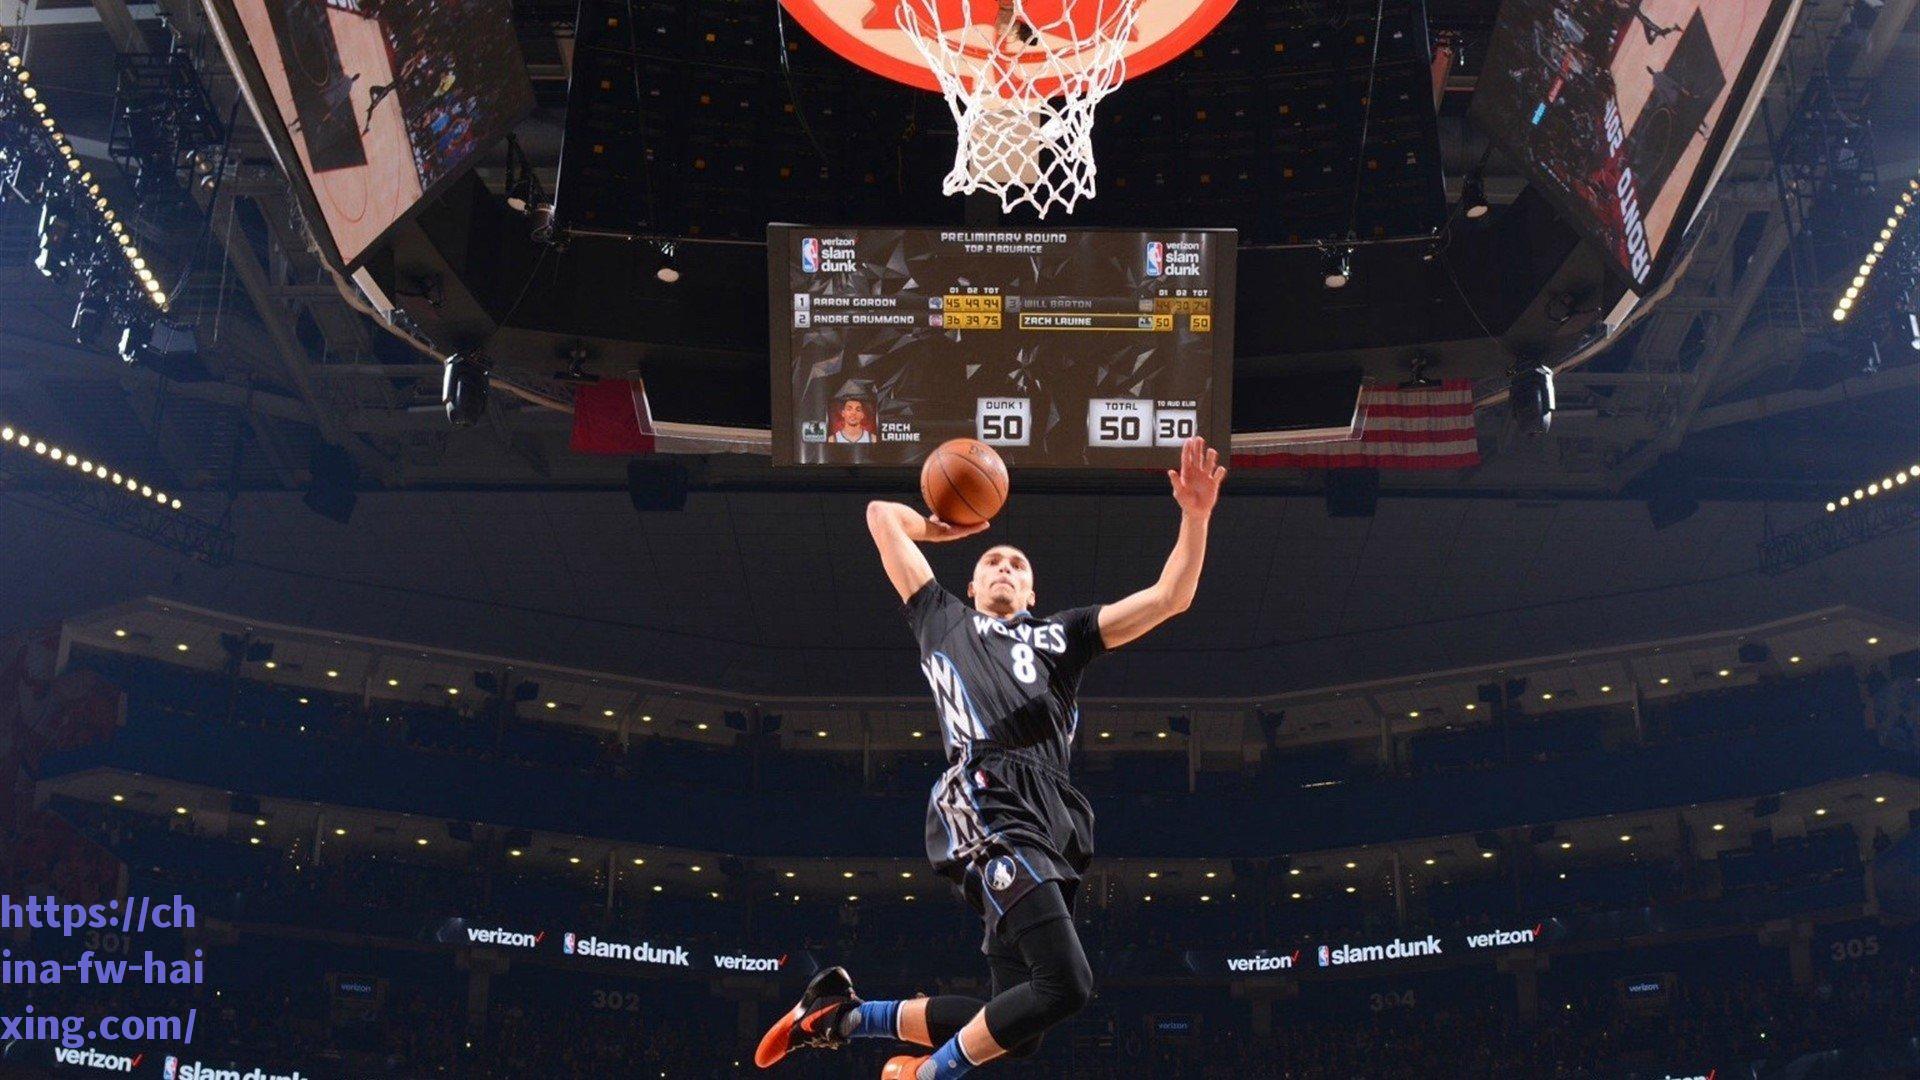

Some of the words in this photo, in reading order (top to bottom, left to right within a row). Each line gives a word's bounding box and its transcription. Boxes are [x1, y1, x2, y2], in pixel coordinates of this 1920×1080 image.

[821, 237, 854, 246] verizon
[940, 232, 1022, 242] PRELIMINARY
[1024, 233, 1067, 243] ROUND
[964, 244, 984, 253] TOP
[986, 244, 993, 253] 2
[995, 244, 1043, 253] ADVANCE
[1166, 242, 1200, 250] verizon
[821, 247, 855, 259] slam
[1165, 251, 1200, 263] slam
[821, 262, 856, 272] dunk
[1164, 264, 1200, 276] dunk
[983, 286, 999, 294] TOT
[799, 297, 805, 307] 1
[813, 298, 850, 307] AARON
[853, 298, 897, 307] GORDON
[946, 299, 960, 307] 45
[965, 299, 980, 308] 49
[984, 299, 999, 308] 94
[1024, 300, 1047, 308] WILL
[1050, 300, 1092, 309] BARTON
[798, 315, 806, 324] 2
[813, 315, 850, 324] ANDRE
[852, 315, 915, 324] DRUMMOND
[966, 315, 980, 325] 39
[984, 315, 999, 325] 75
[1024, 317, 1051, 325] ZACH
[1055, 317, 1092, 326] LAVINE
[1156, 318, 1170, 327] 50
[1193, 318, 1208, 327] 50
[985, 401, 1015, 410] DUNK
[1019, 401, 1023, 410] 1
[1105, 402, 1138, 411] TOTAL
[881, 423, 911, 432] ZACH
[983, 415, 1023, 440] 50
[1100, 416, 1140, 440] 50
[1159, 419, 1193, 438] 30
[881, 433, 920, 442] LAVINE
[1011, 643, 1036, 683] 8
[467, 926, 535, 948] verizon
[1466, 926, 1534, 949] verizon
[1830, 935, 1879, 961] 305
[713, 953, 778, 971] verizon
[1227, 953, 1292, 972] verizon
[592, 990, 640, 1011] 302
[55, 1047, 131, 1072] verizon
